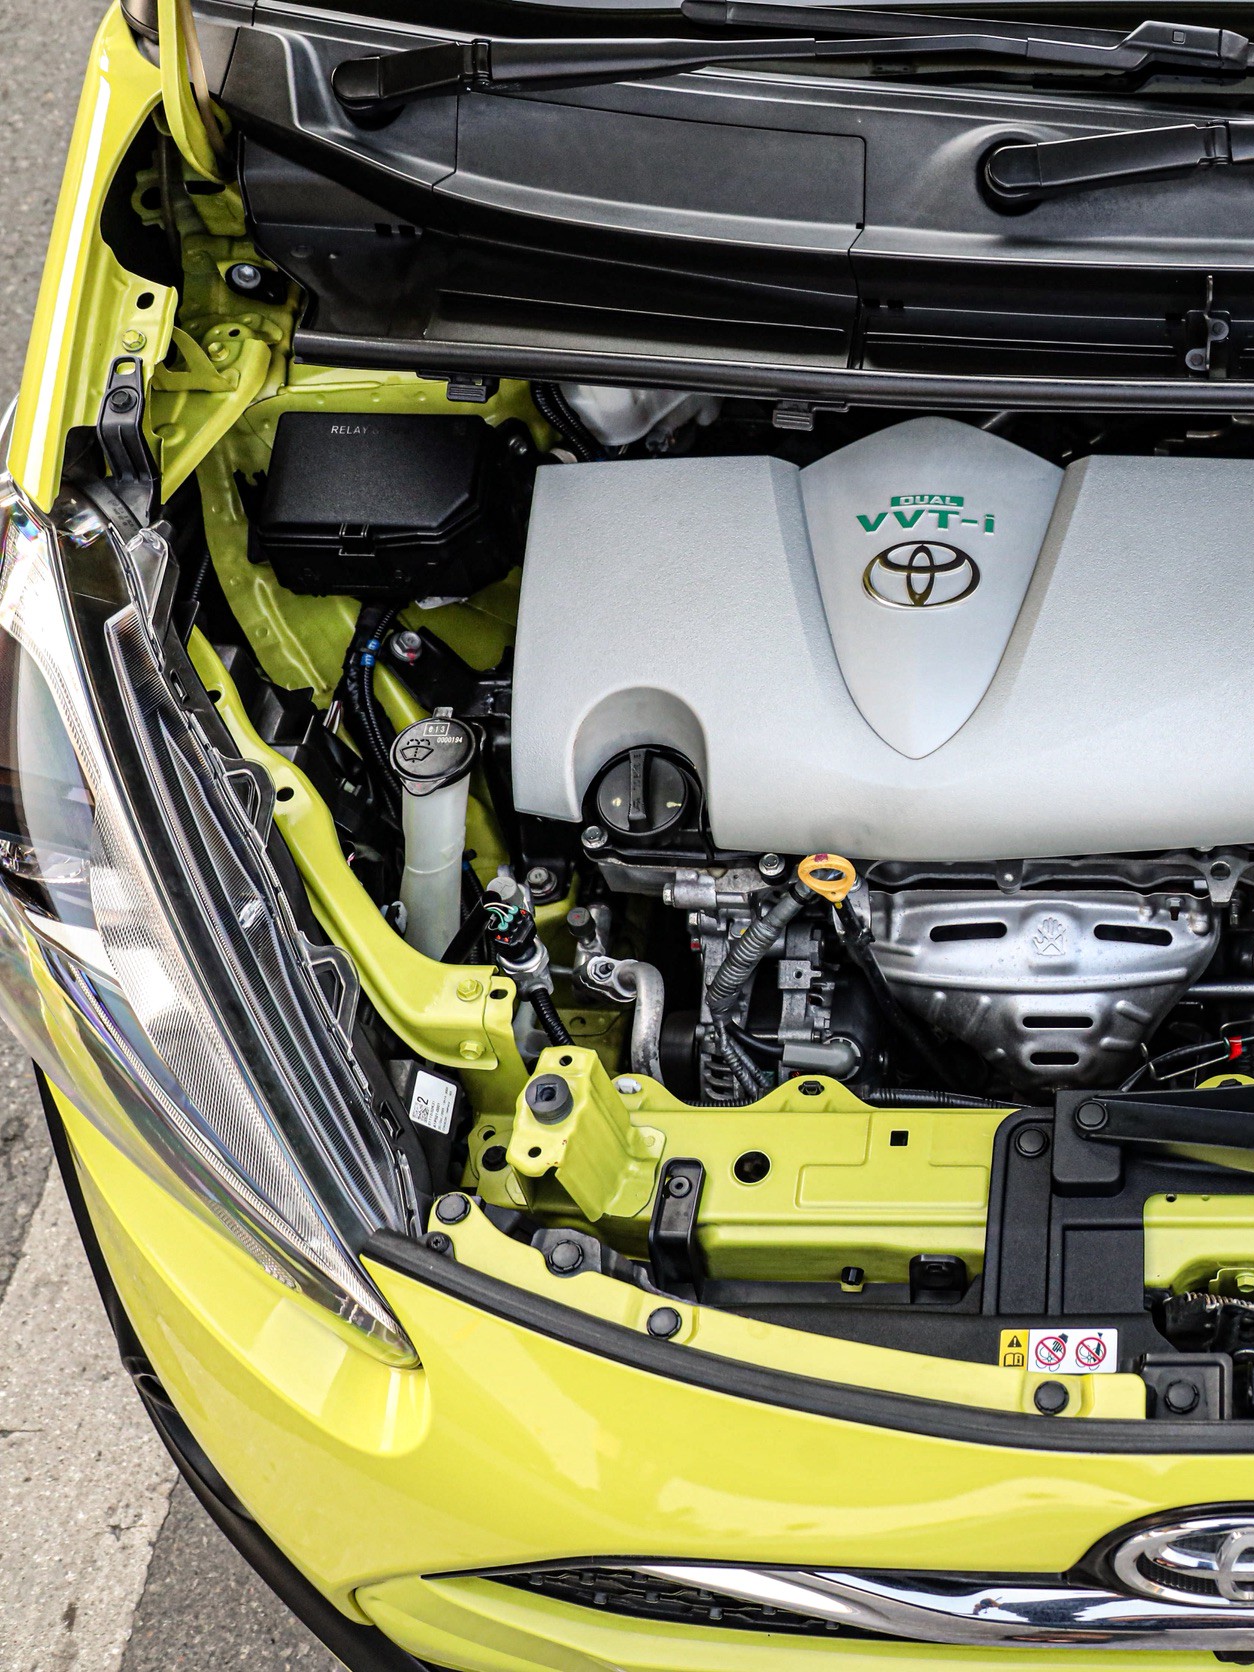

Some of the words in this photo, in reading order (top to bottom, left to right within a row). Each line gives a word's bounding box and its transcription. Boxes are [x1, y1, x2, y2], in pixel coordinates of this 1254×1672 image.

[331, 425, 369, 435] RELAY
[899, 496, 958, 506] DUAL
[855, 509, 995, 535] VVT-i
[416, 1096, 429, 1106] 2
